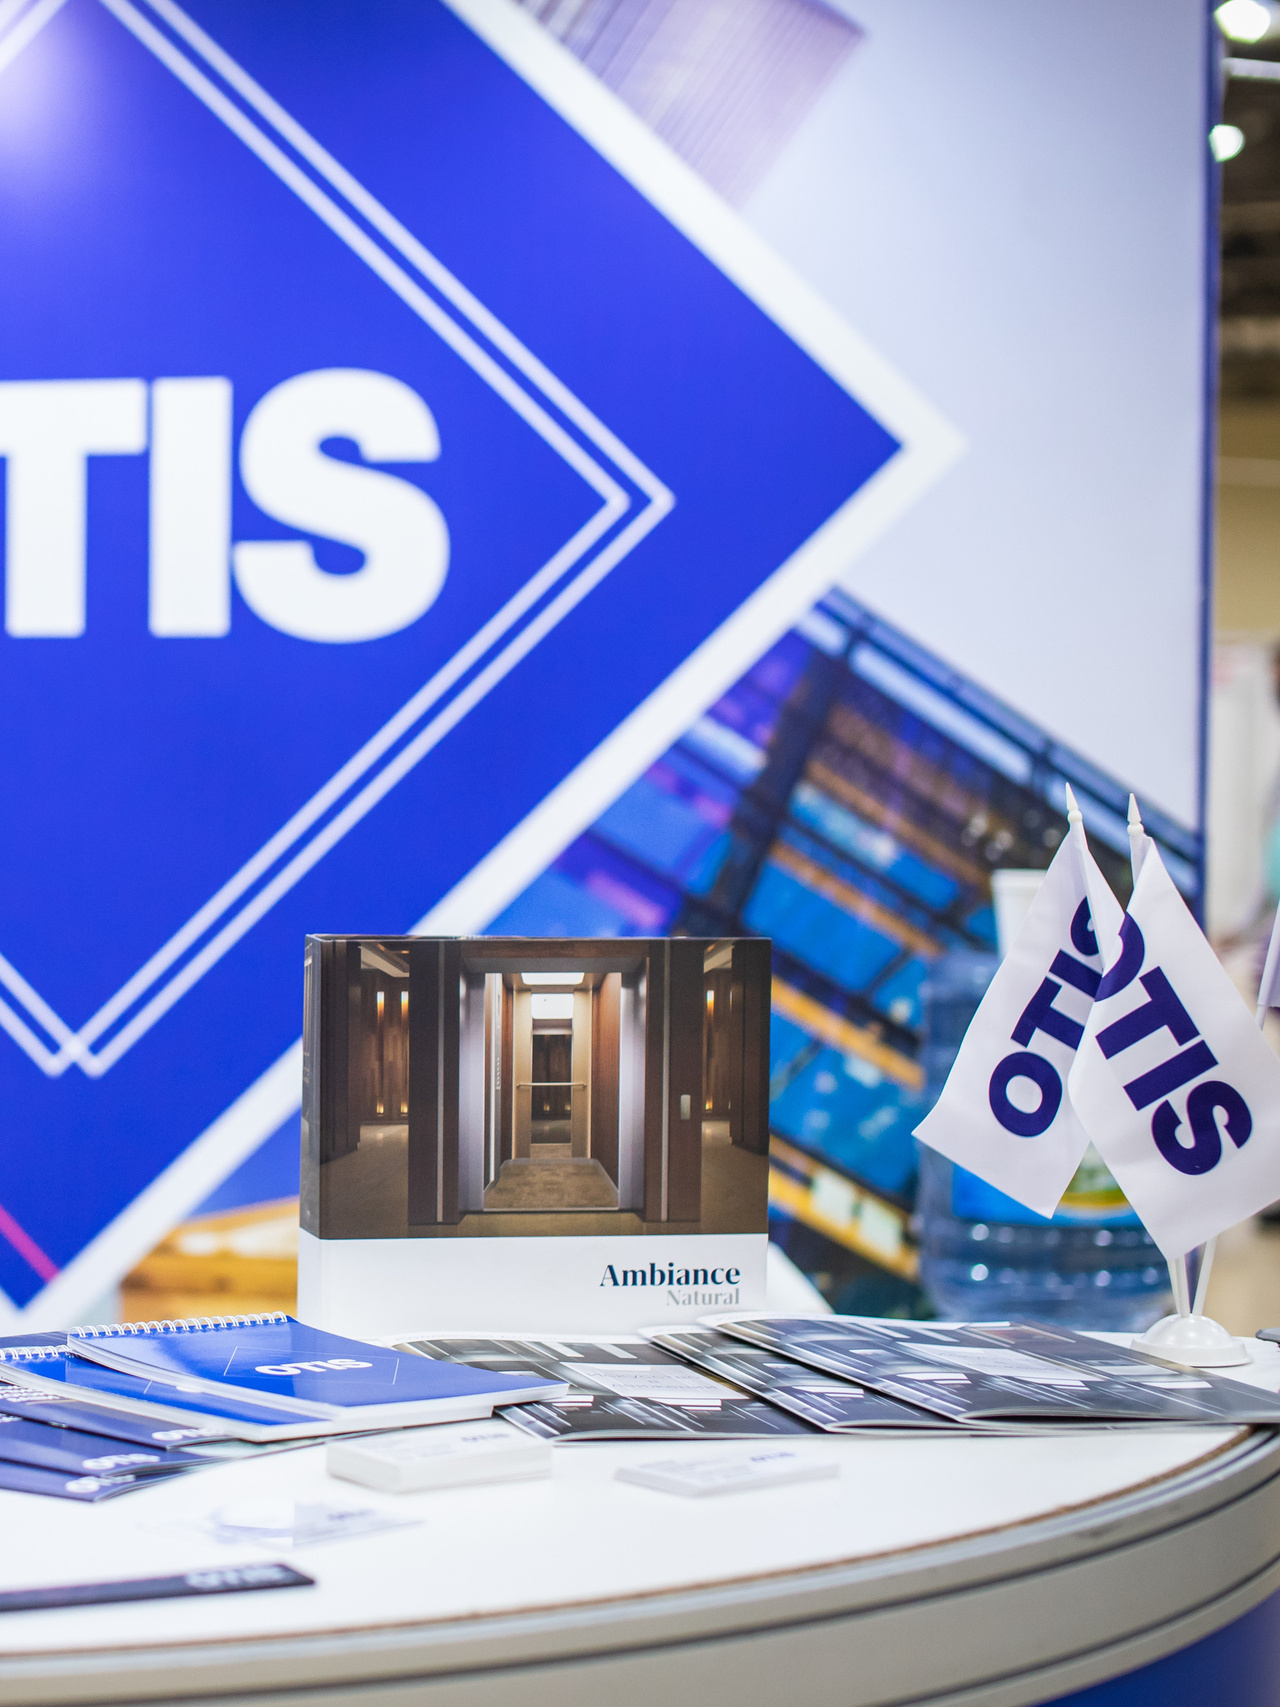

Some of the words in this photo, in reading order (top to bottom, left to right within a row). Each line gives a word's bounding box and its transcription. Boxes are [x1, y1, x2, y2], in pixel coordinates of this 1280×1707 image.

[599, 1261, 741, 1287] Ambiance
[666, 1287, 740, 1306] Natural
[255, 1358, 373, 1375] OTIS
